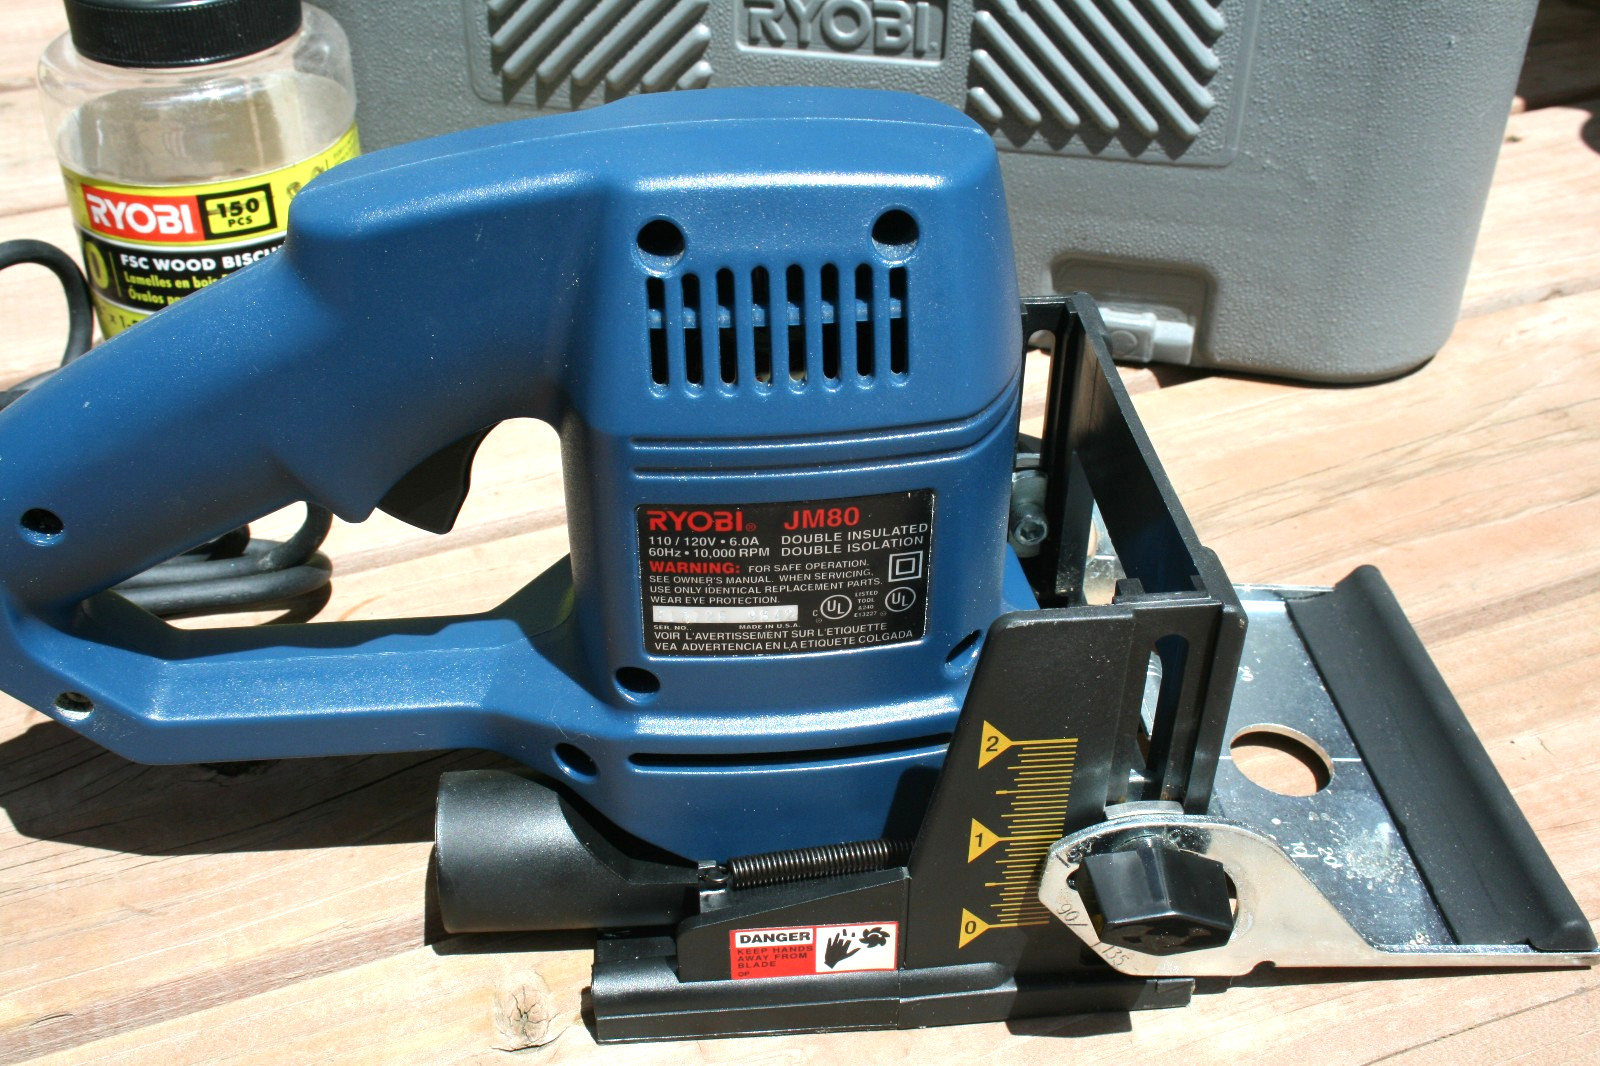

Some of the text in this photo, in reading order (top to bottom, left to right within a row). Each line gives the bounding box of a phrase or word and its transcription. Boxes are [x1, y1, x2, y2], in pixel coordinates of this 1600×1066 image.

[746, 0, 930, 57] RYOBI
[85, 193, 195, 234] RYOBI
[216, 196, 260, 219] 150
[227, 214, 253, 228] PCS
[120, 245, 285, 272] FSC WOOD BISC
[123, 271, 173, 289] Lamelles
[175, 278, 190, 289] en
[646, 506, 860, 532] RYOBI JM80
[649, 536, 672, 546] 110
[684, 536, 716, 547] 120V
[729, 536, 760, 547] 6.0A
[781, 523, 929, 545] DOUBLE INSULATED
[648, 547, 770, 560] 60Hz 10,000 RPM
[781, 536, 924, 557] DOUBLE ISOLATION
[649, 560, 742, 575] WARNING:
[748, 565, 771, 574] FOR
[773, 563, 802, 573] SAFE
[649, 575, 670, 583] SEE
[673, 575, 723, 585] OWNER'S
[779, 573, 811, 582] WHEN
[649, 585, 671, 594] USE
[674, 586, 702, 594] ONLY
[705, 585, 762, 595] IDENTICAL
[764, 581, 844, 594] REPLACEMENT
[650, 595, 682, 604] WEAR
[685, 596, 706, 604] EYE
[654, 622, 888, 641] VOIR L'AVERTISSEMENT SUR L'ETIQUETTE
[654, 629, 913, 651] VEA ADVERTENCIA EN LA ETIQUETE COLGADA
[985, 735, 999, 753] 2
[974, 832, 984, 848] 1
[964, 919, 977, 935] 0
[739, 931, 811, 944] DANGER
[737, 945, 814, 956] KEEP HANDS
[737, 952, 808, 962] AWAY FROM
[738, 960, 776, 969] BLADE
